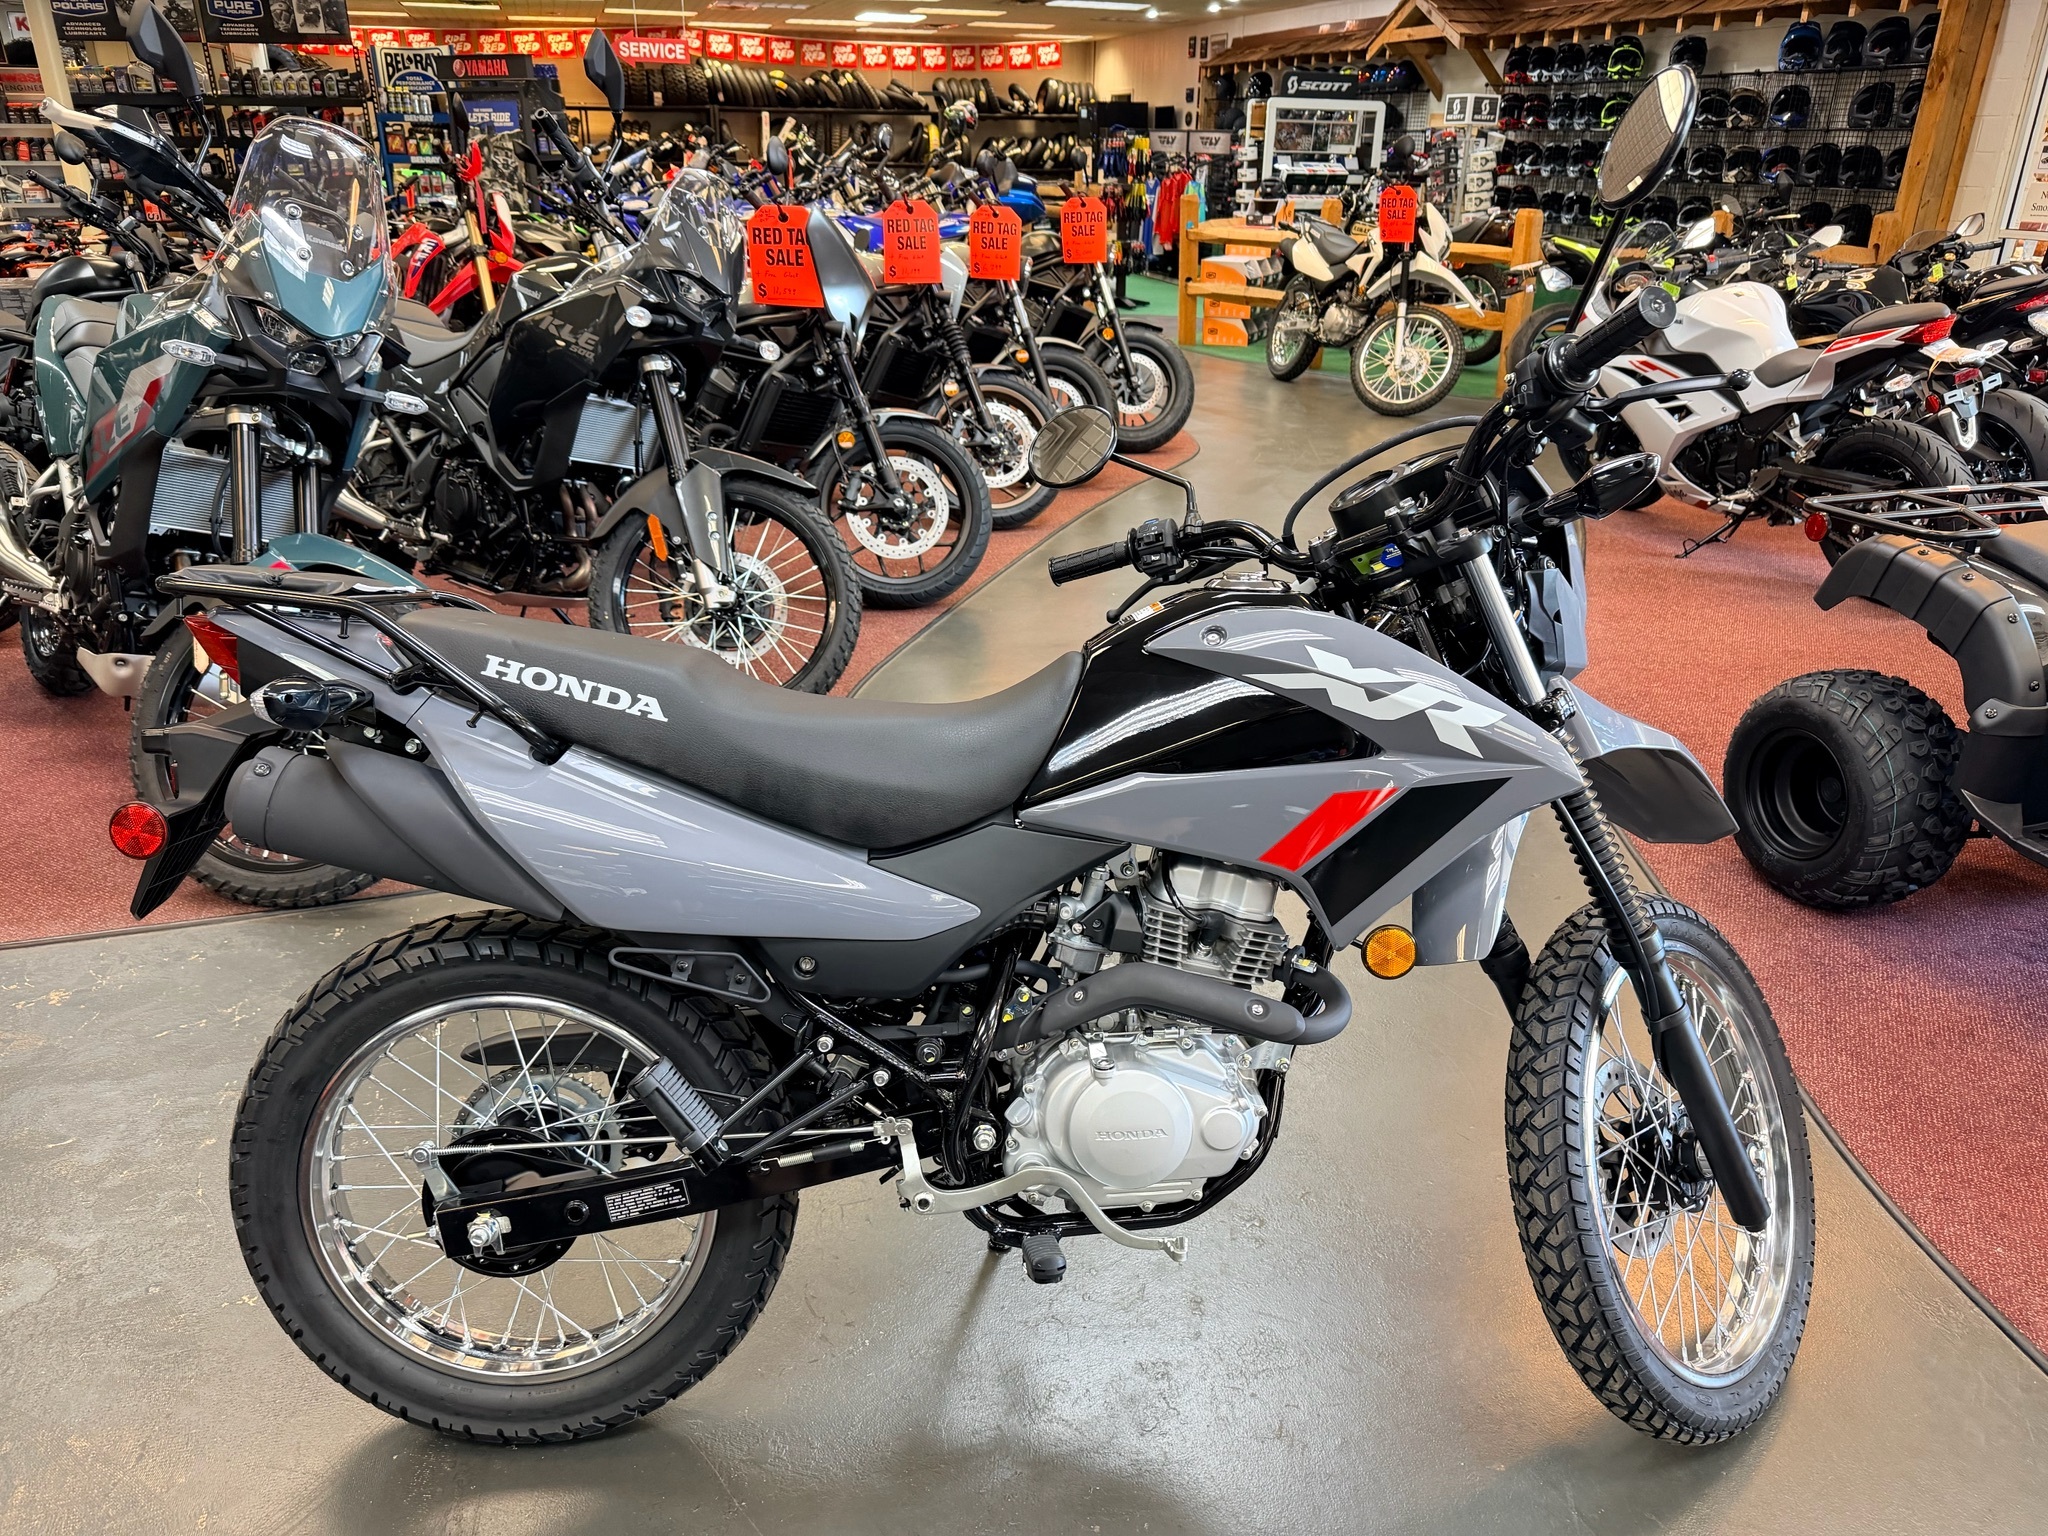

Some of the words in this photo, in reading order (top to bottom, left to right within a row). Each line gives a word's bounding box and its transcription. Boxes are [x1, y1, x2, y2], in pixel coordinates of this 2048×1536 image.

[53, 2, 105, 10] POLARIS
[214, 0, 255, 10] PURE
[619, 41, 686, 59] SERVICE
[465, 59, 509, 76] YAMAHA
[1299, 81, 1352, 91] SCOTT
[468, 112, 490, 122] LET'S
[490, 112, 511, 122] RIDE
[1381, 198, 1397, 208] RED
[1399, 198, 1414, 208] TAG
[1064, 211, 1083, 223] RED
[1085, 211, 1103, 222] TAG
[1387, 210, 1407, 219] SALE
[887, 219, 910, 233] RED
[915, 218, 935, 233] TAG
[973, 221, 994, 234] RED
[997, 222, 1017, 236] TAG
[1071, 225, 1095, 237] SALE
[752, 227, 782, 245] RED
[786, 228, 806, 245] TA
[897, 236, 927, 250] SALE
[981, 236, 1008, 250] SALE
[766, 248, 804, 266] SALE
[539, 315, 600, 351] KLE
[570, 344, 595, 359] 500
[480, 654, 669, 722] HONDA
[1241, 644, 1507, 759] XR
[1095, 1128, 1169, 1141] HONDA
